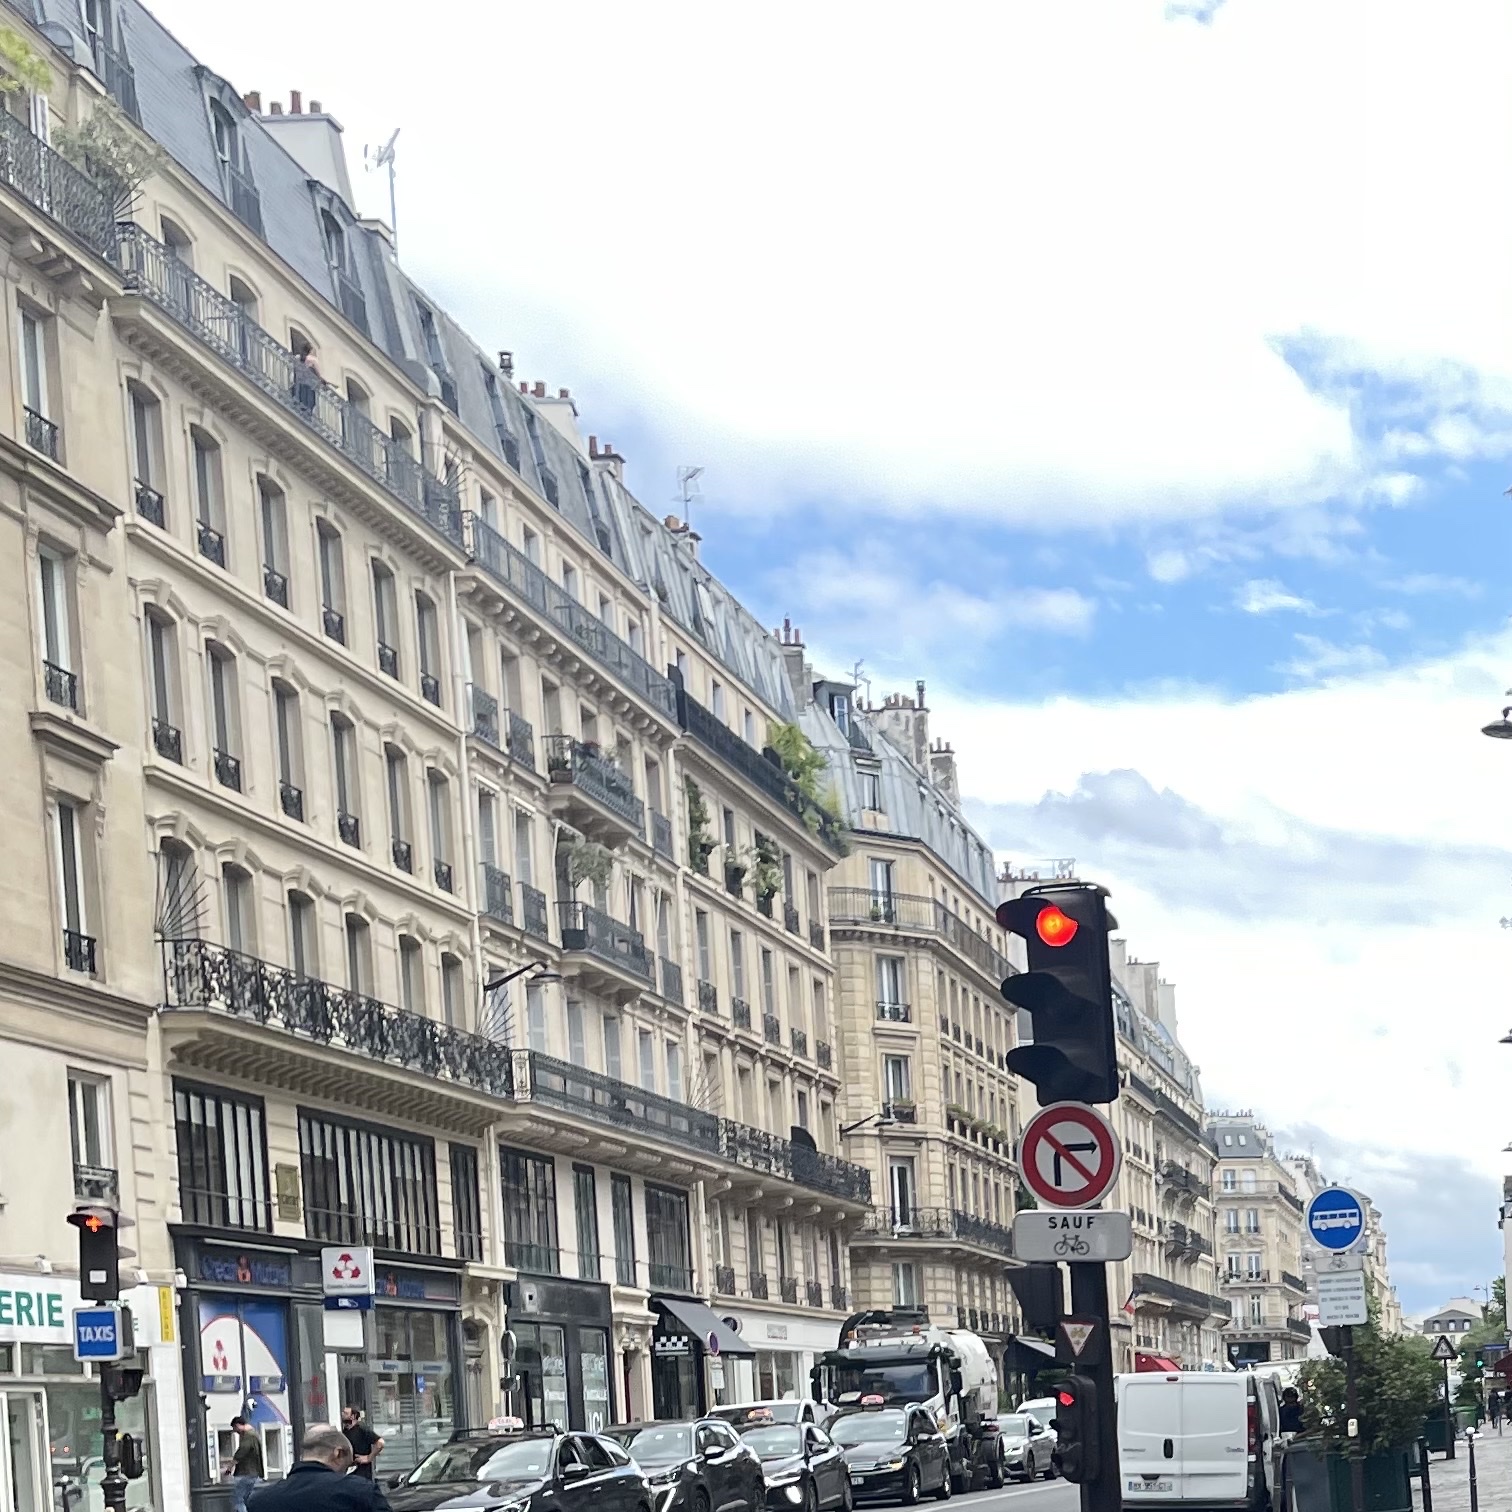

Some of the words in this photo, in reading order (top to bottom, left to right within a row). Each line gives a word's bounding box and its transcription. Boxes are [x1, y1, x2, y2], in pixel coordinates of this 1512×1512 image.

[1048, 1216, 1095, 1229] SAUF
[0, 1290, 64, 1327] ERIE
[79, 1326, 114, 1342] TAXIS
